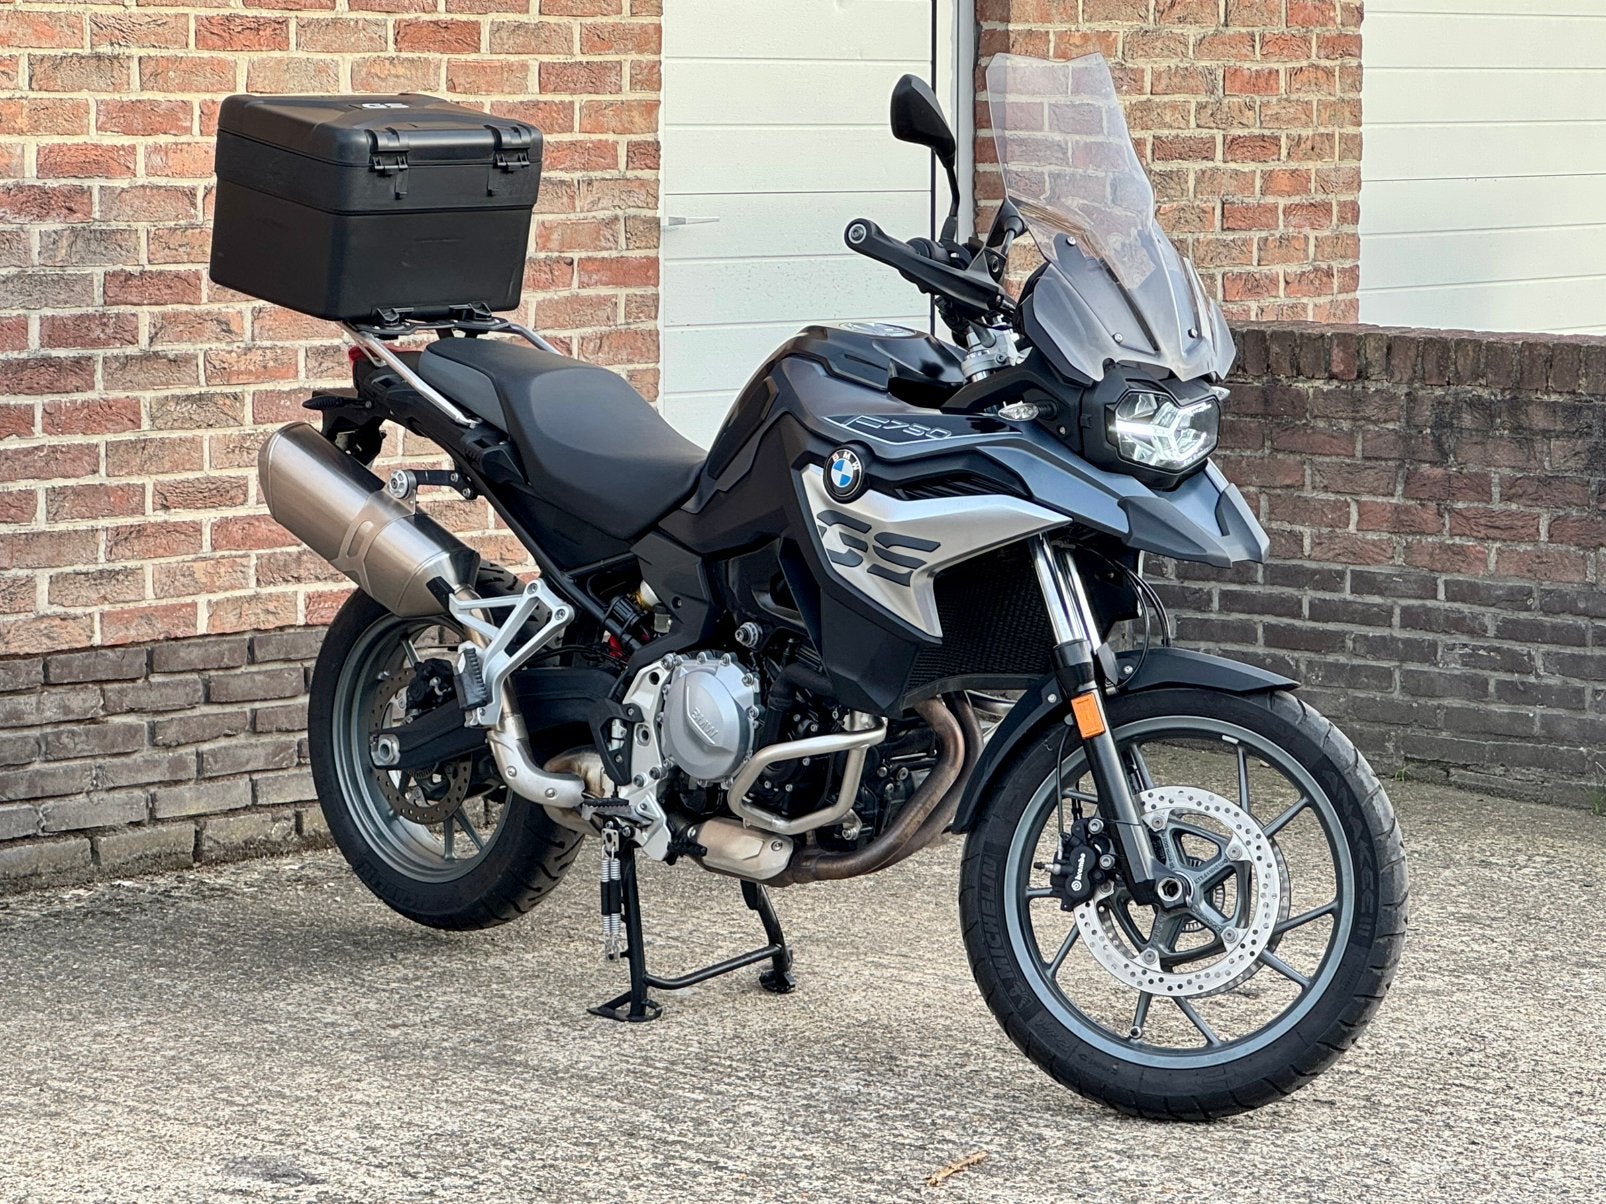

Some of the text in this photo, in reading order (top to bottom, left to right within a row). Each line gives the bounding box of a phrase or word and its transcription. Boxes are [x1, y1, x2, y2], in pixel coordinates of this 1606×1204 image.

[832, 451, 860, 470] BMW
[816, 509, 941, 588] GS
[691, 707, 719, 737] BMW
[1075, 852, 1086, 880] brembo
[981, 858, 1015, 980] MICHELIN
